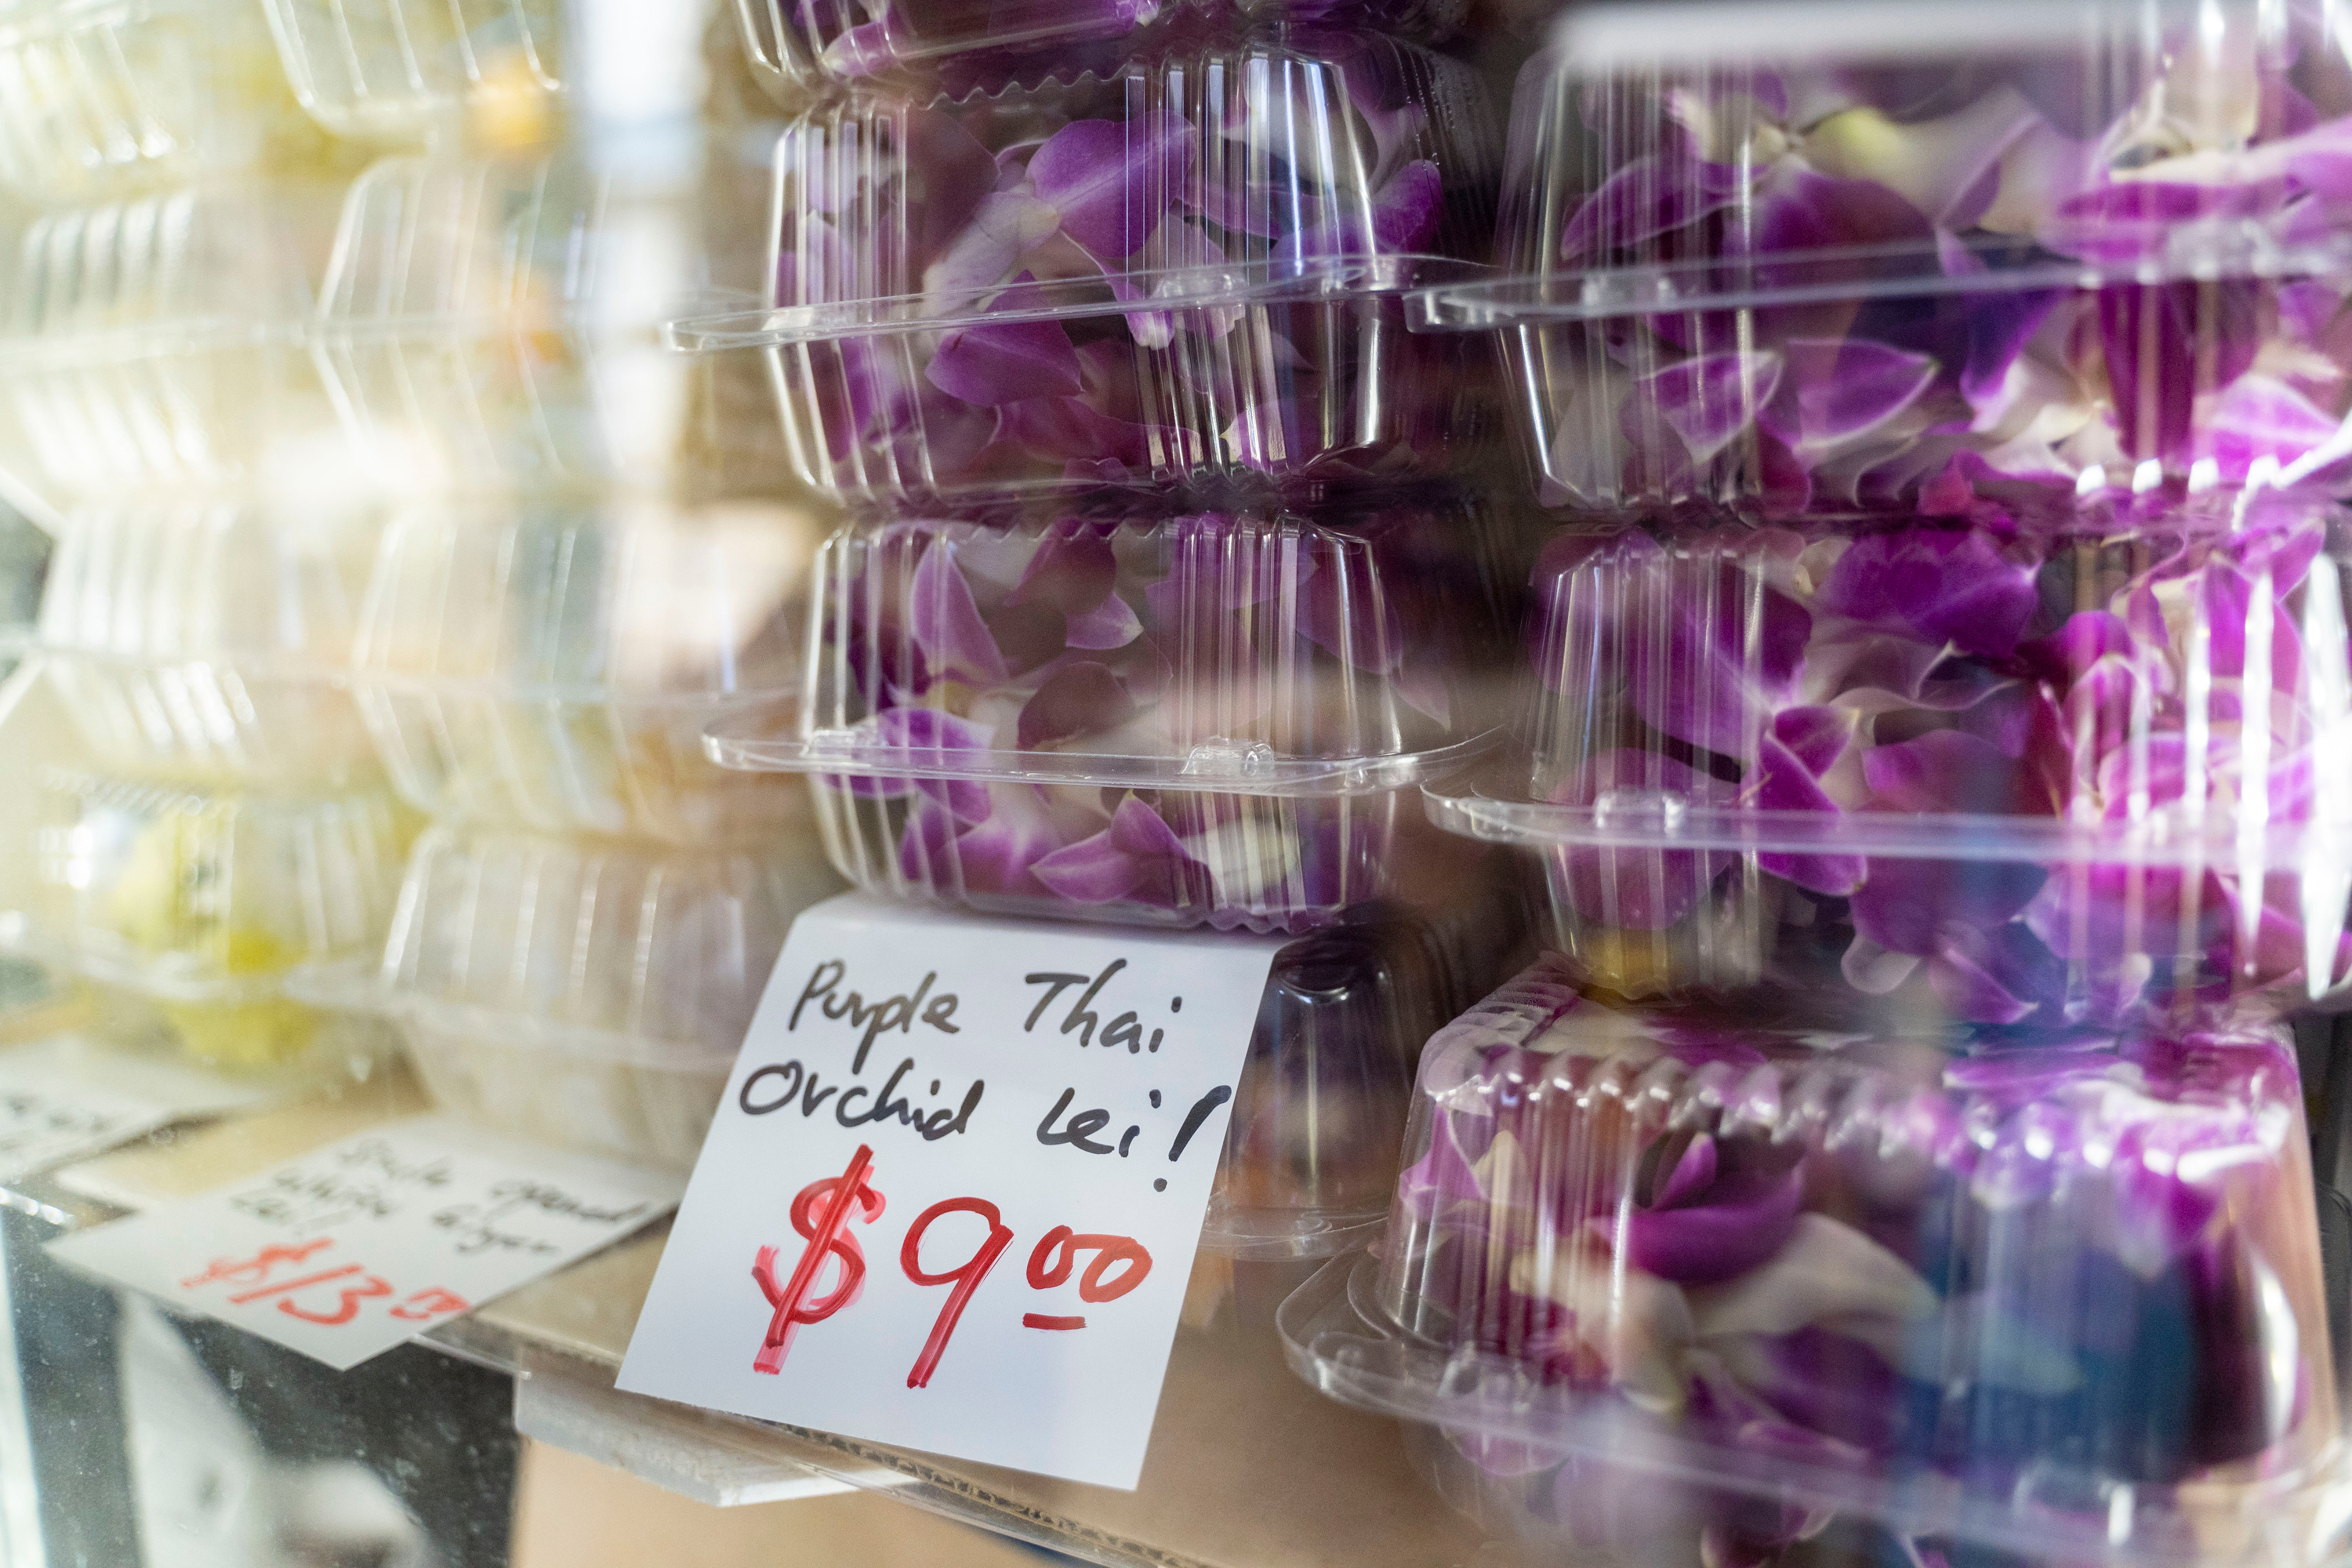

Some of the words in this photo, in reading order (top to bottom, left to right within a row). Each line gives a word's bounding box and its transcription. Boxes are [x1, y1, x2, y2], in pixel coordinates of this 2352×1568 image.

[788, 958, 961, 1076] Purple
[1023, 957, 1184, 1055] Thai
[739, 1057, 985, 1142] Orchid
